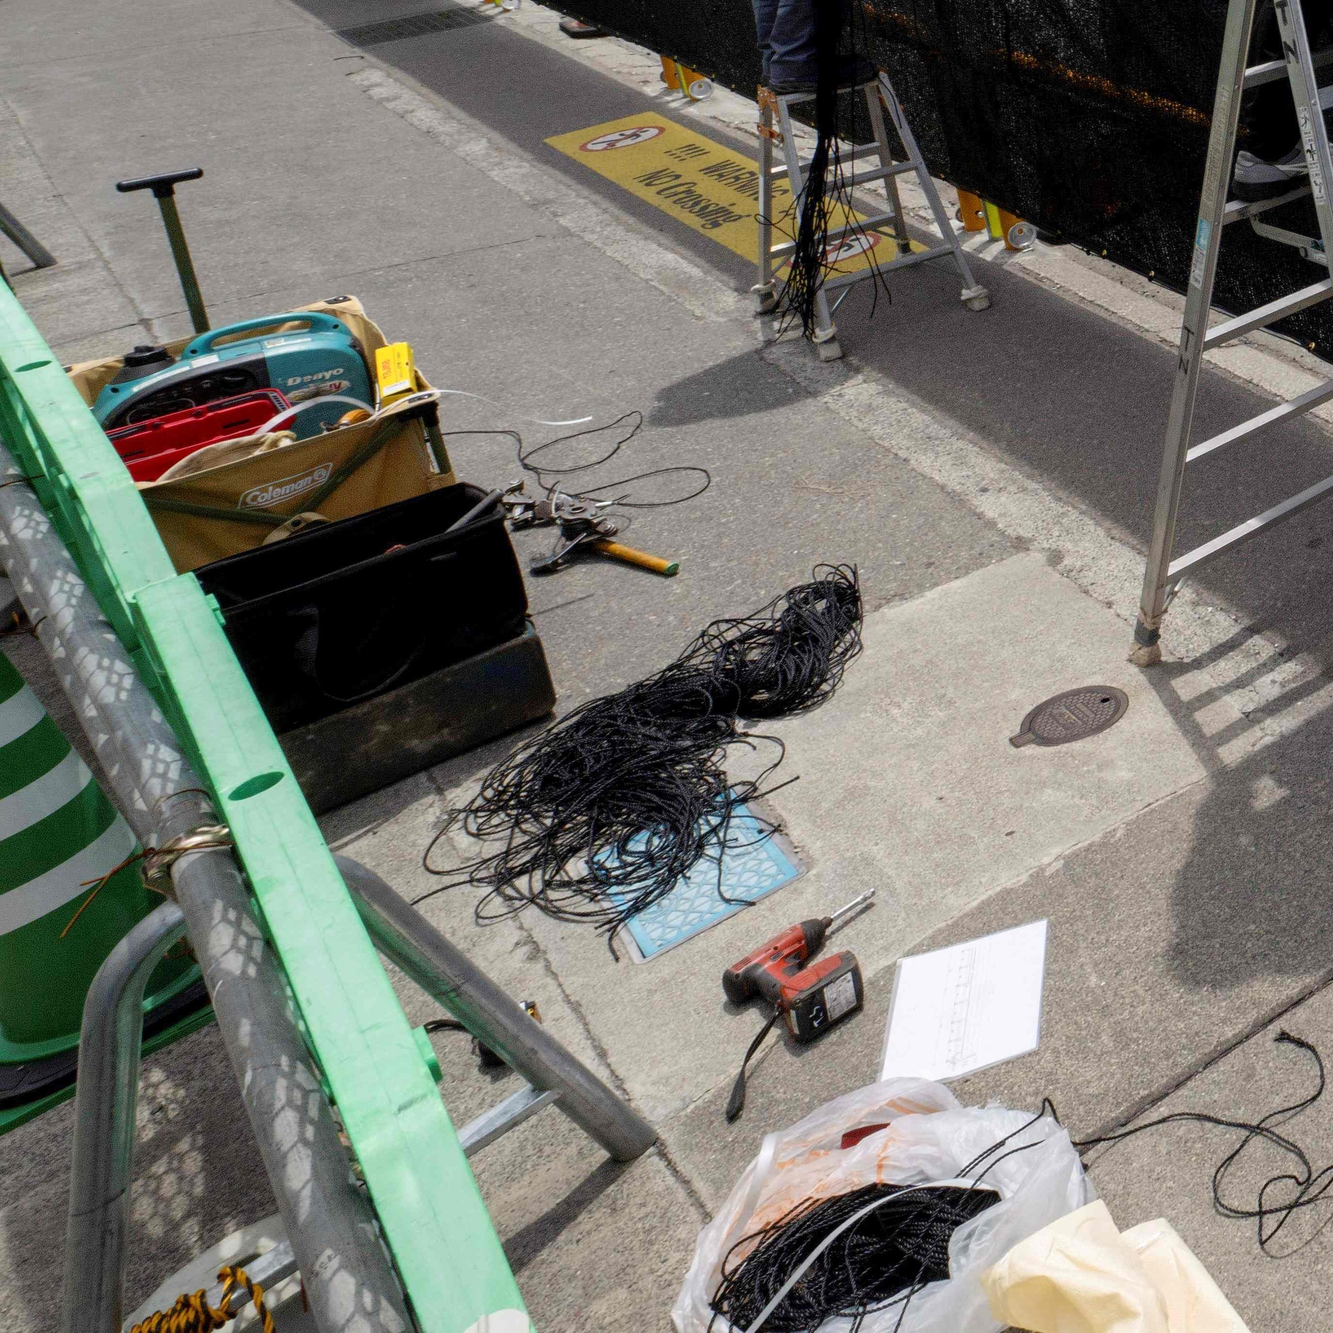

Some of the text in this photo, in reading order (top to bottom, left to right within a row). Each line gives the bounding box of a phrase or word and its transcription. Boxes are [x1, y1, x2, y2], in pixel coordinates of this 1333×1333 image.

[632, 167, 683, 187] NO
[655, 181, 752, 230] Crossing
[245, 476, 313, 505] Coleman
